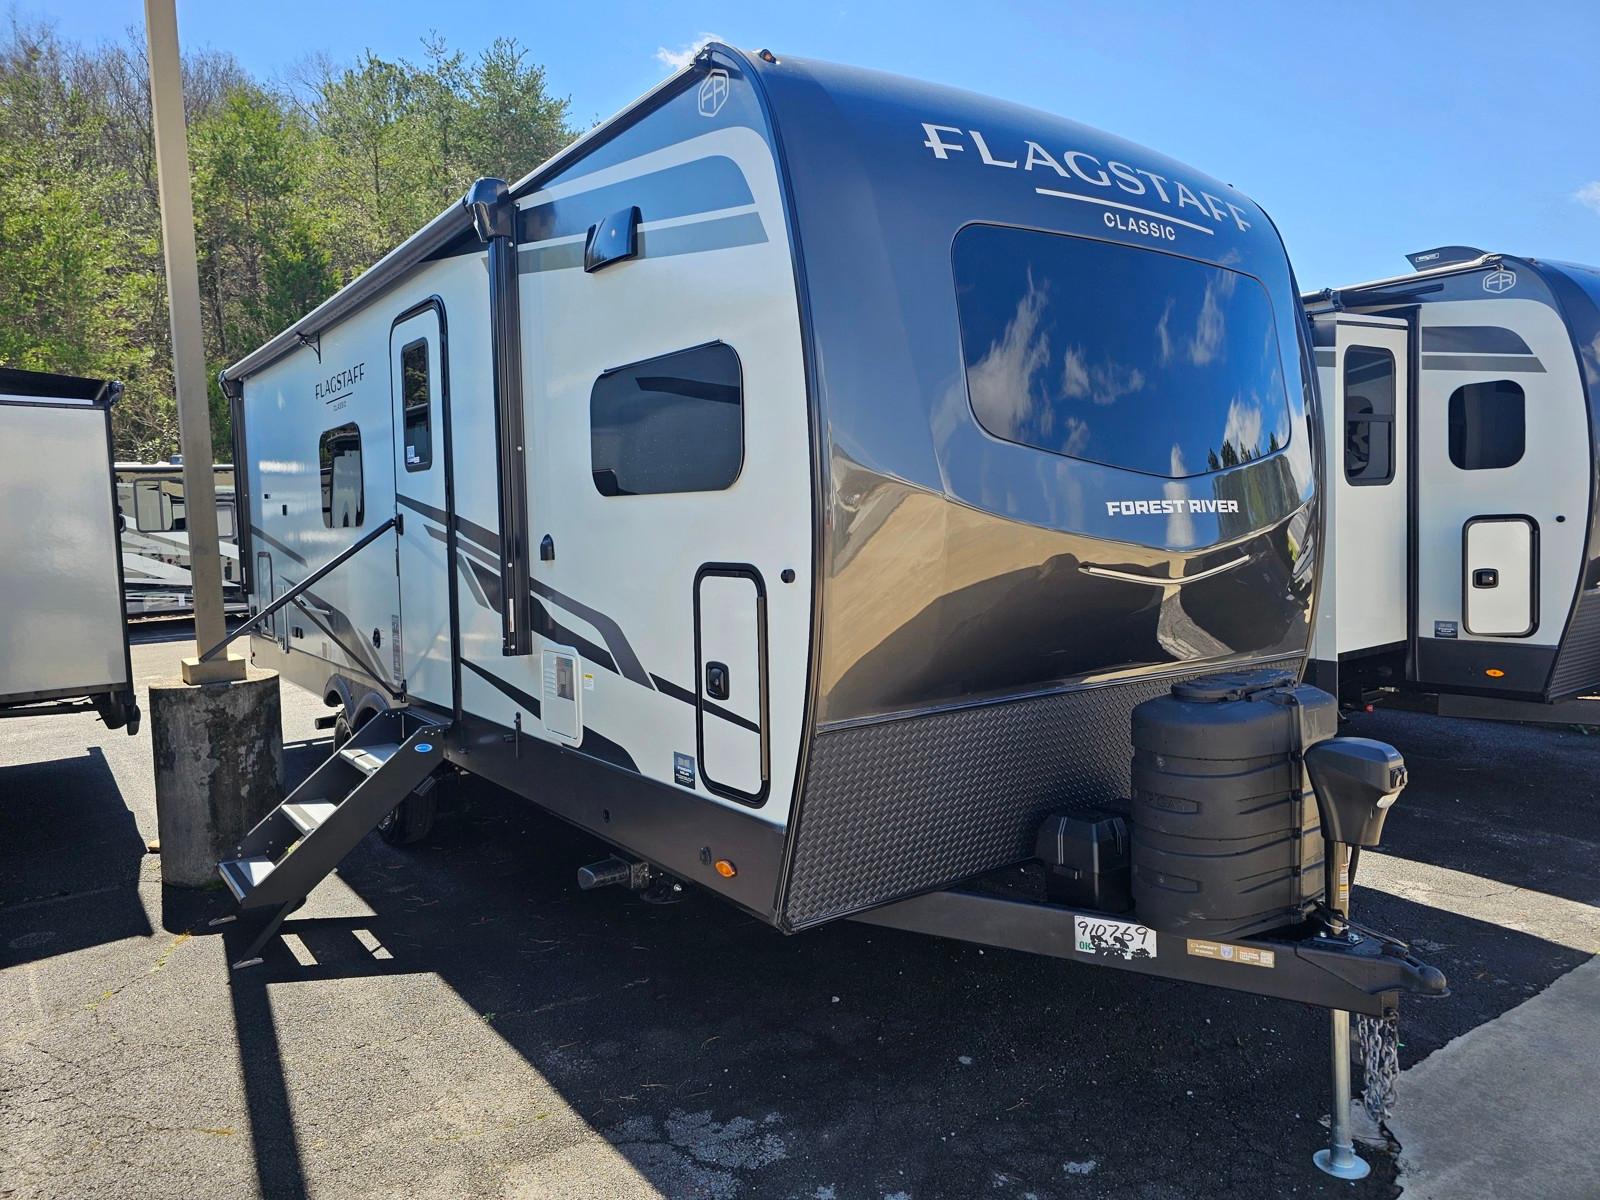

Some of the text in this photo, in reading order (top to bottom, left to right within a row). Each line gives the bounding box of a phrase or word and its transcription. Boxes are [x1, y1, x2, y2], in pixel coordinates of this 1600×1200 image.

[921, 122, 1252, 233] FLAGSTAFF
[1103, 211, 1176, 242] CLASSIC
[315, 362, 365, 399] FLAGSTAFF
[1106, 499, 1239, 516] FOREST RIVER
[1077, 920, 1149, 945] 910769
